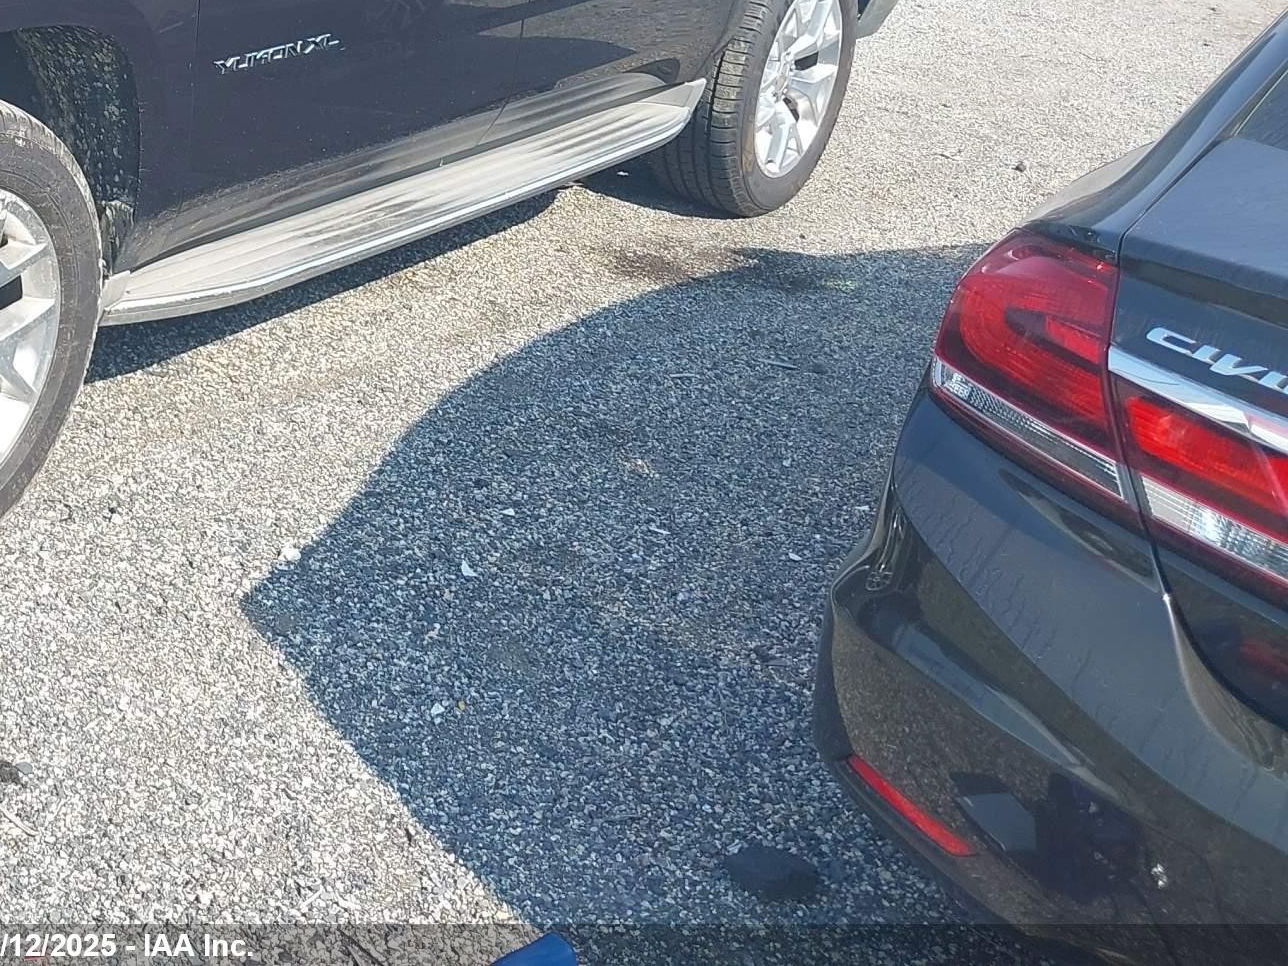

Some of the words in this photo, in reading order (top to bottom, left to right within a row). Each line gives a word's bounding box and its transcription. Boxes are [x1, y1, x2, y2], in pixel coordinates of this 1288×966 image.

[213, 40, 303, 75] YUKON
[303, 33, 340, 55] XL
[1146, 327, 1288, 396] CIVI
